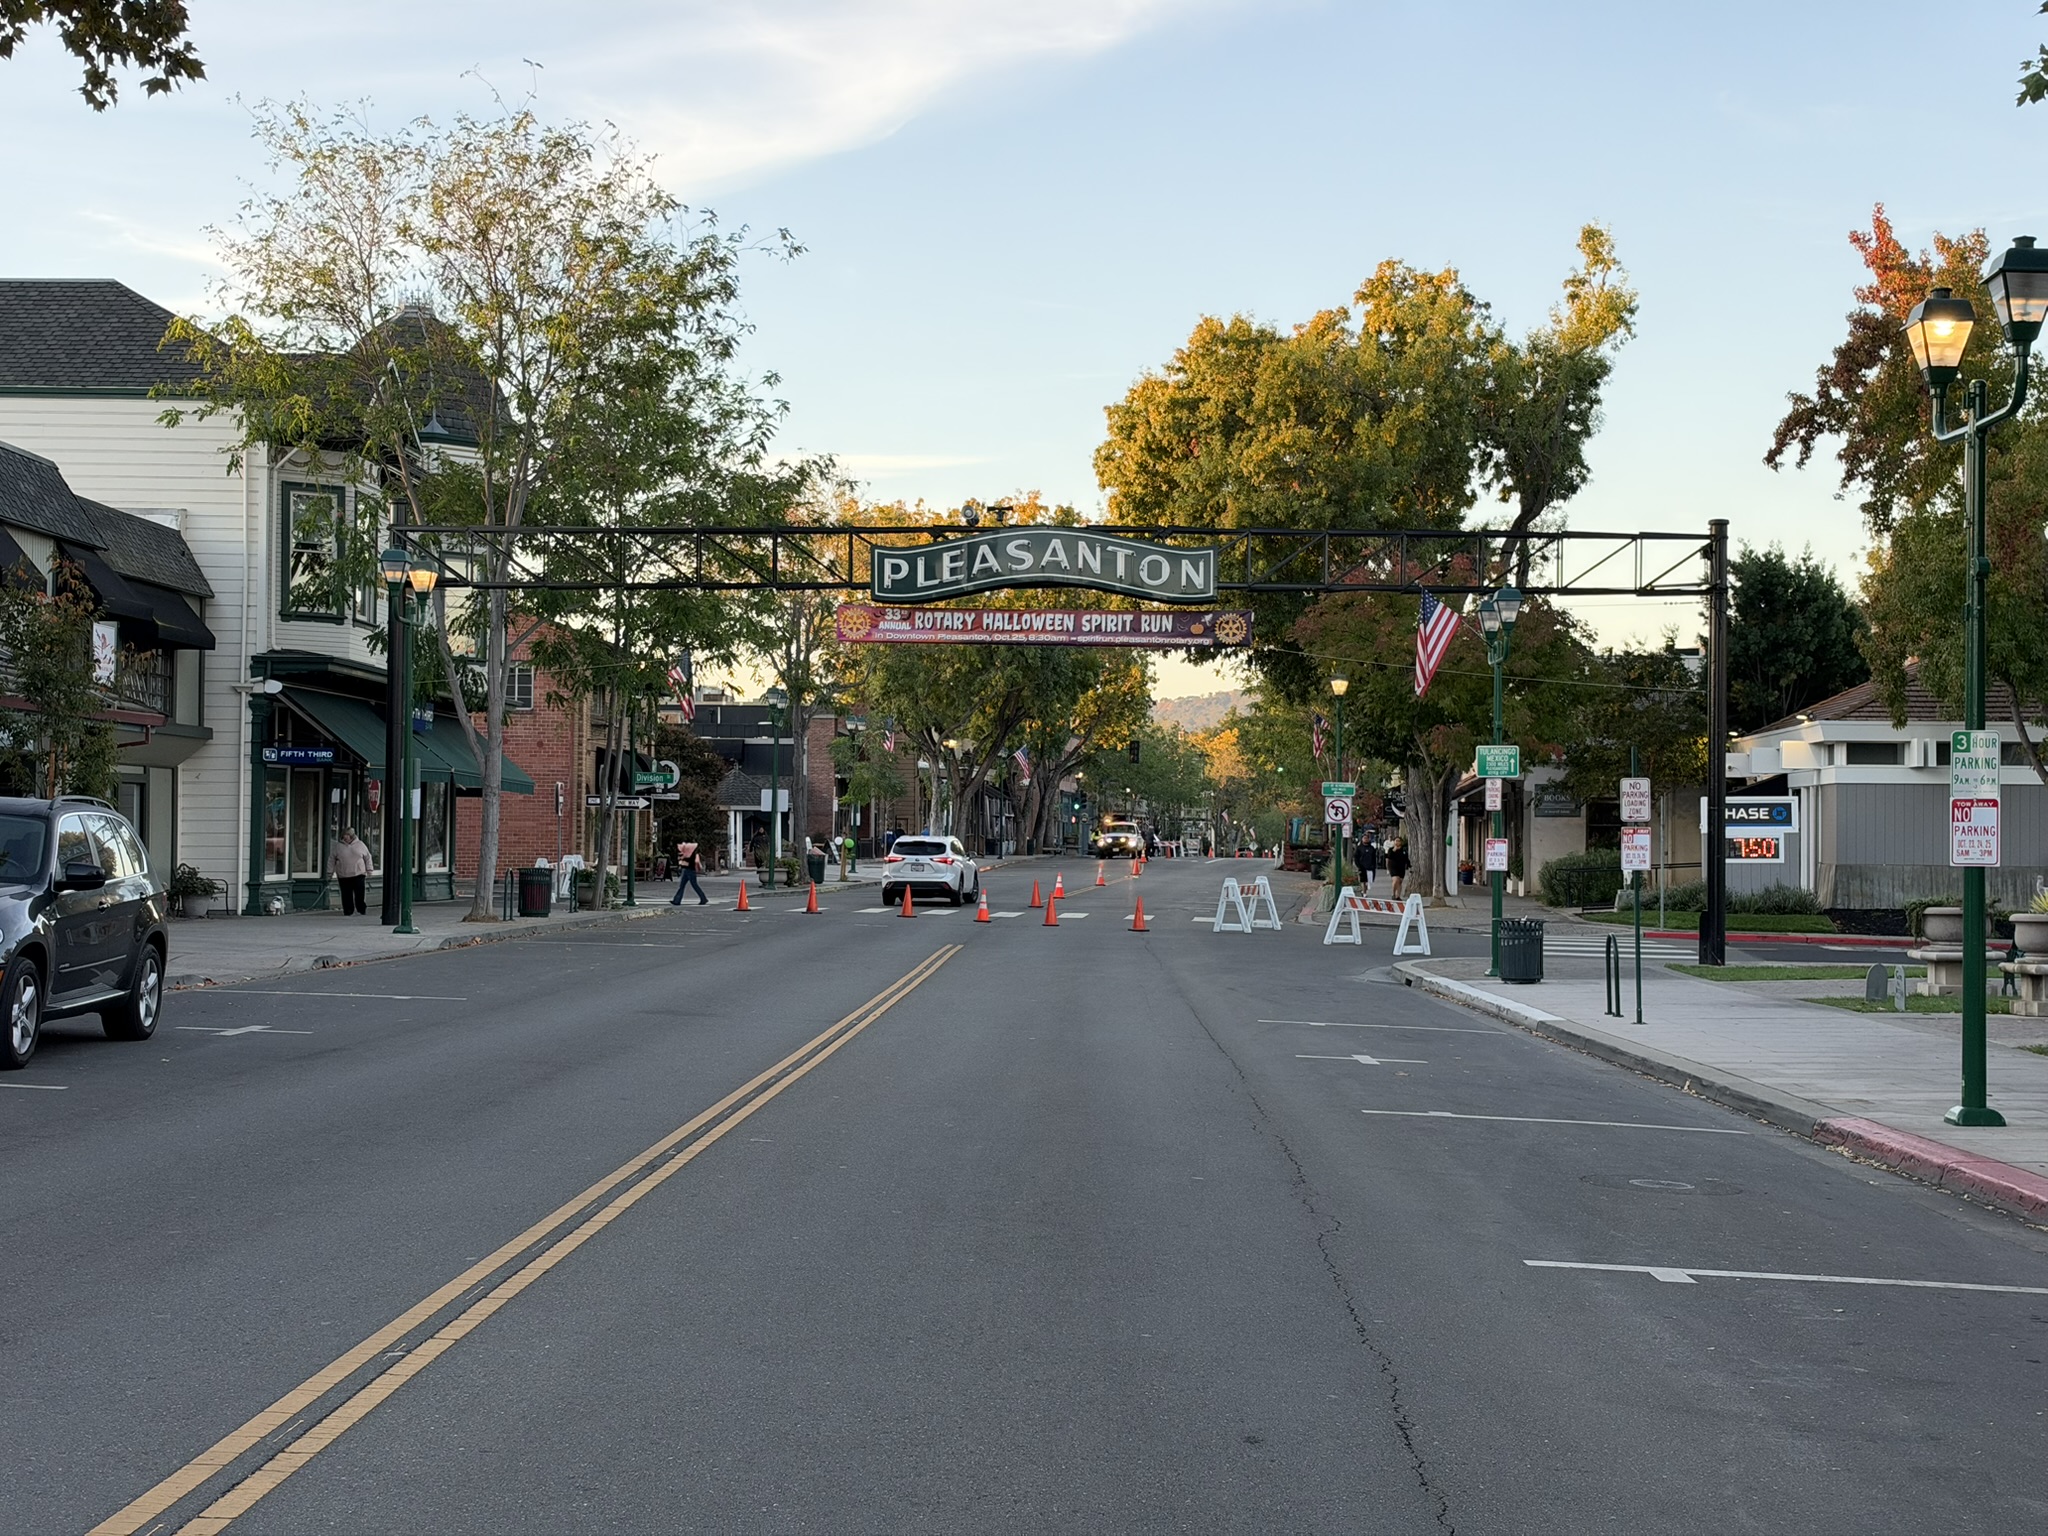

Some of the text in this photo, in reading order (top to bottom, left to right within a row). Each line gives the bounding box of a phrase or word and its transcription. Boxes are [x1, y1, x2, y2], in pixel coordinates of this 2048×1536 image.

[883, 538, 1206, 591] PLEASANTON
[878, 620, 911, 630] ANNUAL
[914, 611, 1173, 633] ROTARY HALLOWEEN SPIRIT RUN
[886, 632, 936, 640] Downtown
[1956, 735, 1998, 750] 3 HOUR
[1954, 757, 1997, 770] PARKING
[636, 773, 664, 782] Division
[1629, 782, 1641, 790] NO
[1622, 791, 1648, 799] PARKING
[1725, 807, 1770, 820] HASE
[1954, 807, 1971, 822] NO
[1954, 825, 1996, 837] PARKING
[1623, 834, 1633, 843] NO
[1623, 844, 1648, 852] PARKING
[1956, 849, 1970, 857] 5AM
[1979, 849, 1993, 857] 3PM
